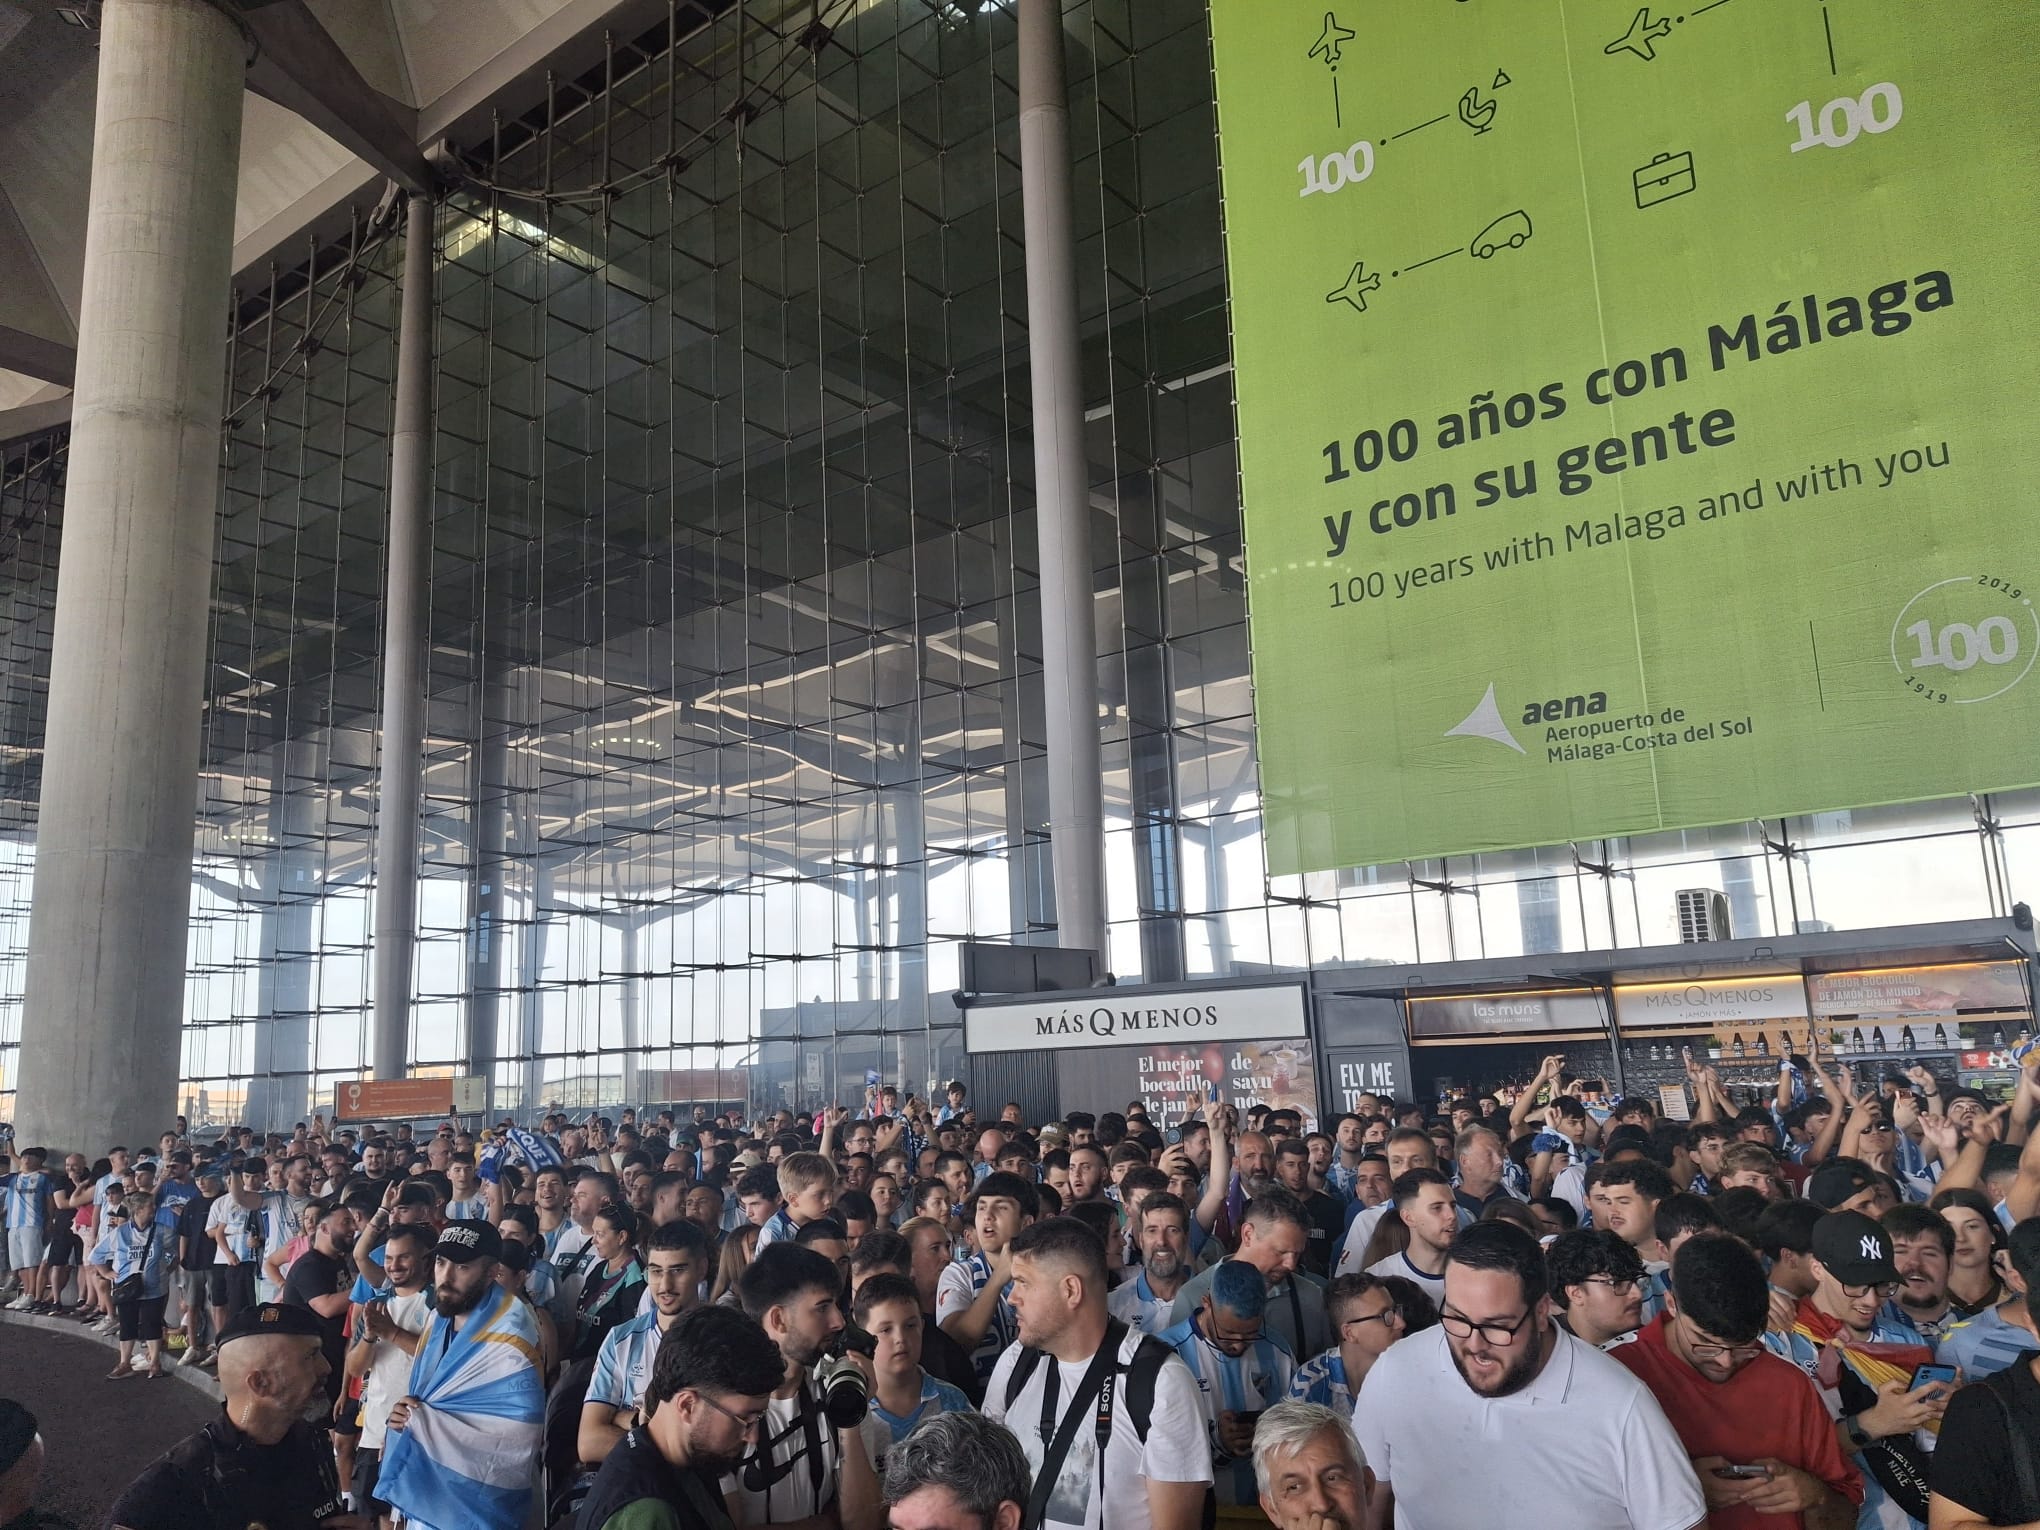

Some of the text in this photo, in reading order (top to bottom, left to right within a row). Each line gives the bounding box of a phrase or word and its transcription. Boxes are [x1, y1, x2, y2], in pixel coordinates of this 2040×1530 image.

[1784, 81, 1904, 153] 100
[1297, 140, 1375, 198] 100
[1322, 269, 1955, 484] 100 años con Málaga
[1323, 407, 1736, 558] y con su gente
[1329, 441, 1950, 608] 100 years with Malaga and with you
[1978, 574, 2022, 599] 2019
[1906, 616, 2019, 671] 100
[1904, 675, 1948, 704] 1919
[1522, 691, 1607, 725] aena
[1546, 707, 1685, 743] Aeropuerto de
[1547, 717, 1753, 763] Málaga-Costa del Sol
[1819, 991, 1831, 1001] DE
[1867, 988, 1883, 999] DEL
[1886, 986, 1921, 998] MUNDO
[1830, 977, 1859, 989] MEJOR
[1863, 974, 1915, 986] BOCADILLO
[1473, 1003, 1542, 1017] las muns
[1138, 1056, 1204, 1076] El mejor
[1231, 1052, 1252, 1070] de
[1340, 1062, 1395, 1087] FLY ME
[1140, 1075, 1211, 1093] bocadillo
[1860, 1235, 1882, 1260] NY
[1101, 1375, 1112, 1412] SONY
[1888, 1460, 1911, 1487] NIKE
